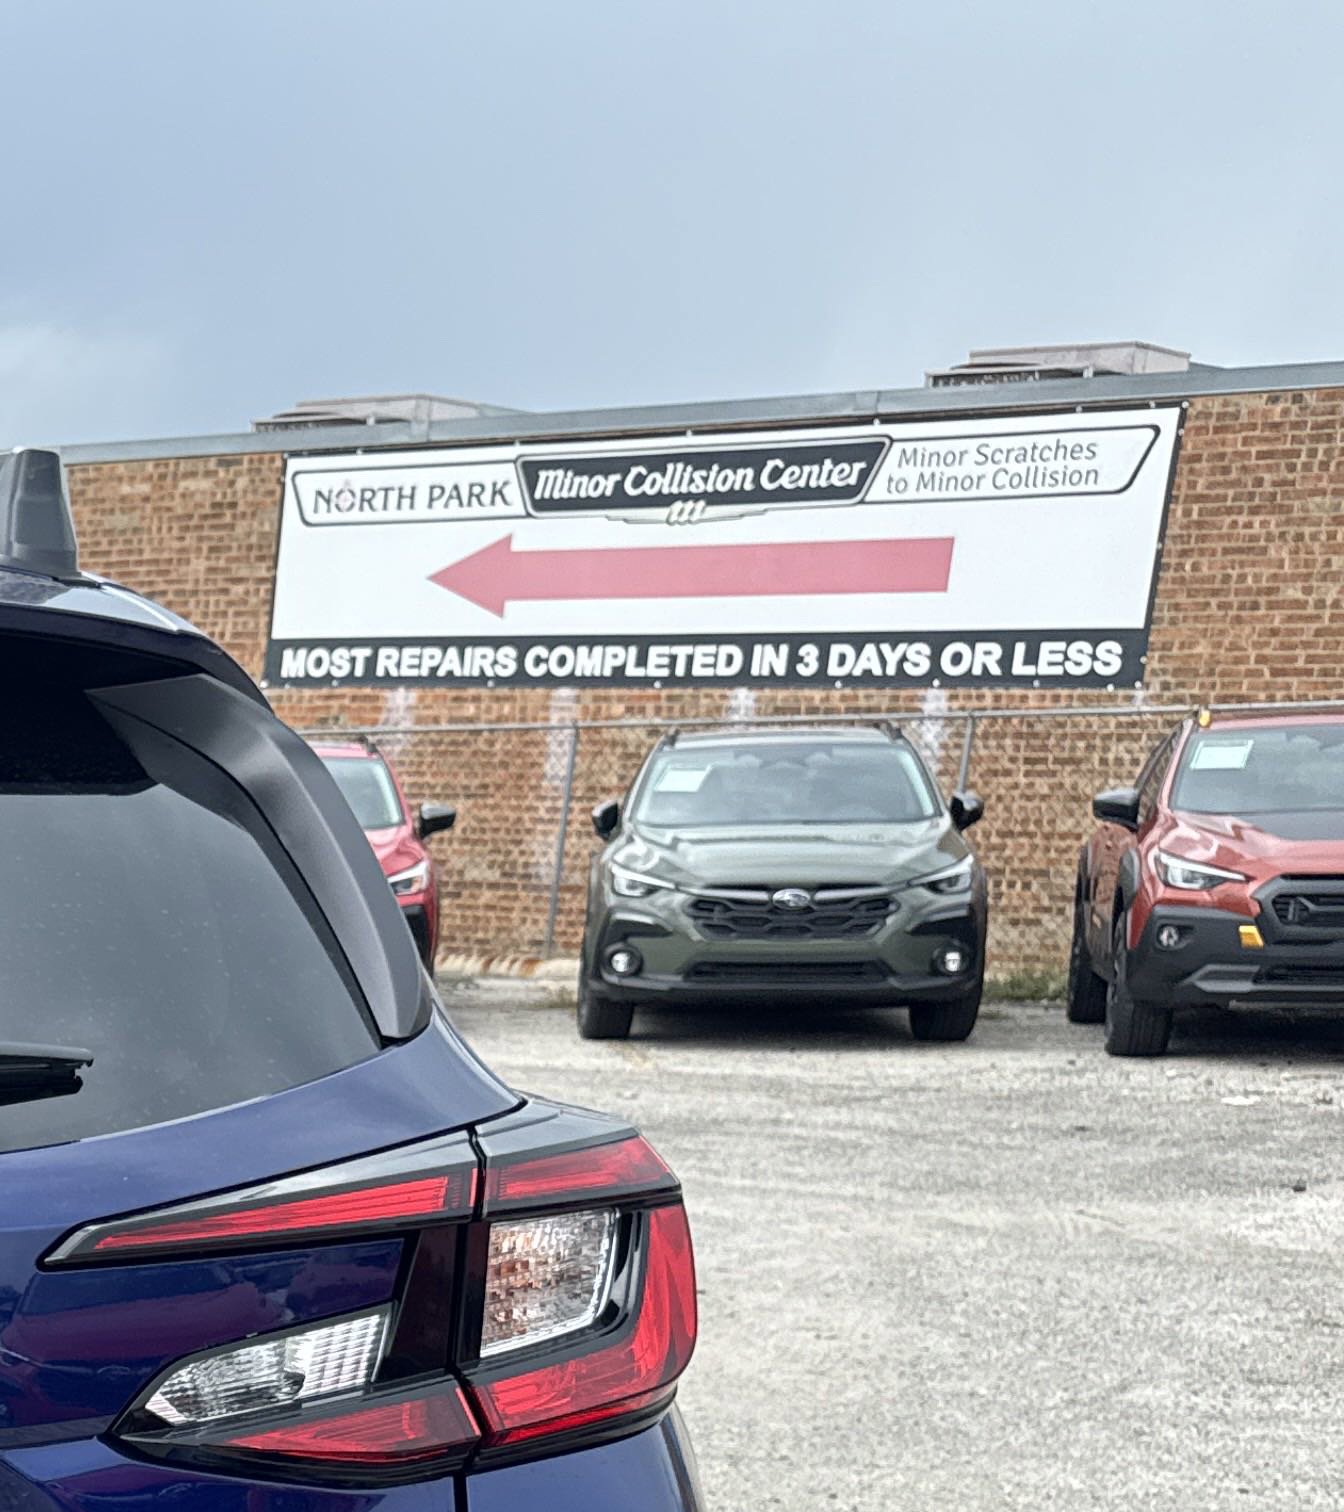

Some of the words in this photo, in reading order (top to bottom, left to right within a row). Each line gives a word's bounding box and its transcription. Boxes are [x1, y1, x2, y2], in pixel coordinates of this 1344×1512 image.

[897, 447, 966, 468] Minor
[974, 439, 1098, 466] Scratches
[534, 468, 621, 499] Minor
[624, 461, 756, 496] Collision
[760, 458, 867, 491] Center
[887, 474, 908, 494] to
[915, 470, 986, 493] Minor
[991, 465, 1099, 489] Collision
[313, 485, 418, 514] NORTH
[427, 480, 513, 509] PARK
[280, 647, 371, 679] MOST
[375, 645, 517, 678] REPAIRS
[524, 642, 744, 678] COMPLETED
[750, 644, 789, 677] IN
[795, 644, 820, 677] 3
[826, 643, 931, 677] DAYS
[940, 642, 1003, 676] OR
[1011, 641, 1123, 676] LESS
